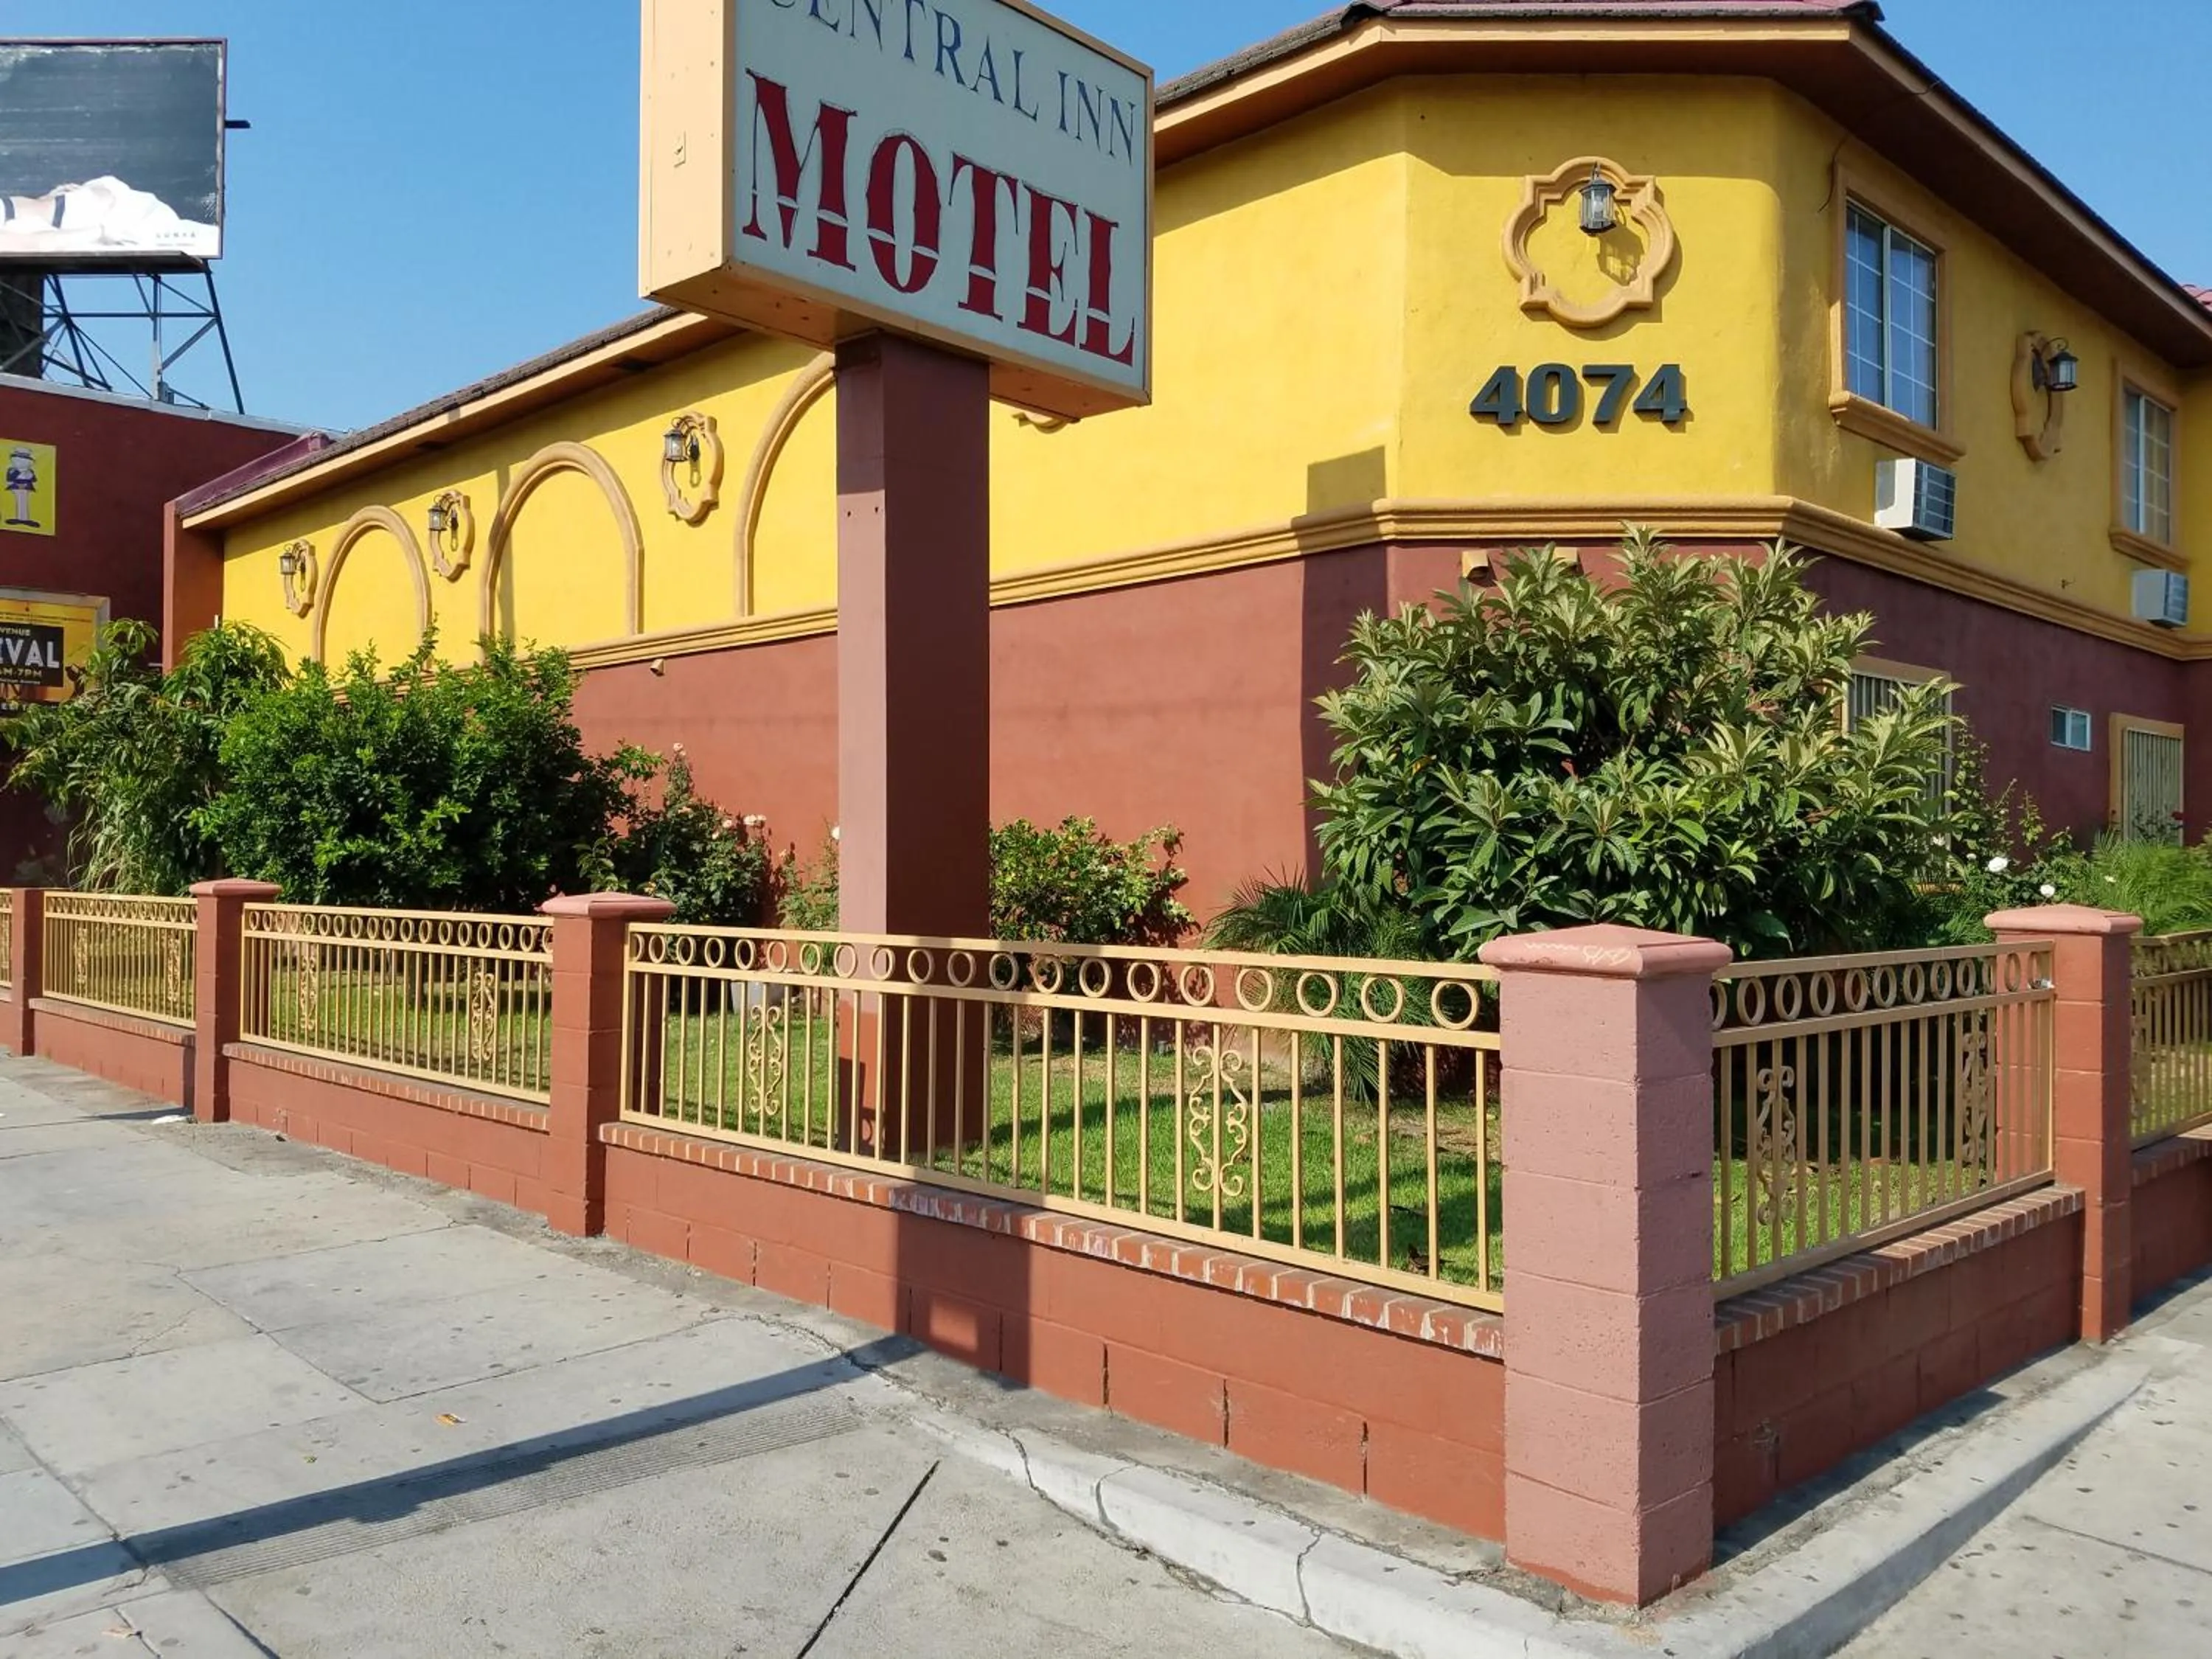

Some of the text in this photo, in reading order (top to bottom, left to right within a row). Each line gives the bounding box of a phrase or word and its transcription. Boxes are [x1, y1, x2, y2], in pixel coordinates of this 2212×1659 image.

[771, 0, 1135, 166] NTRAL INN
[742, 68, 1135, 366] MOTEL
[1469, 363, 1687, 424] 4074
